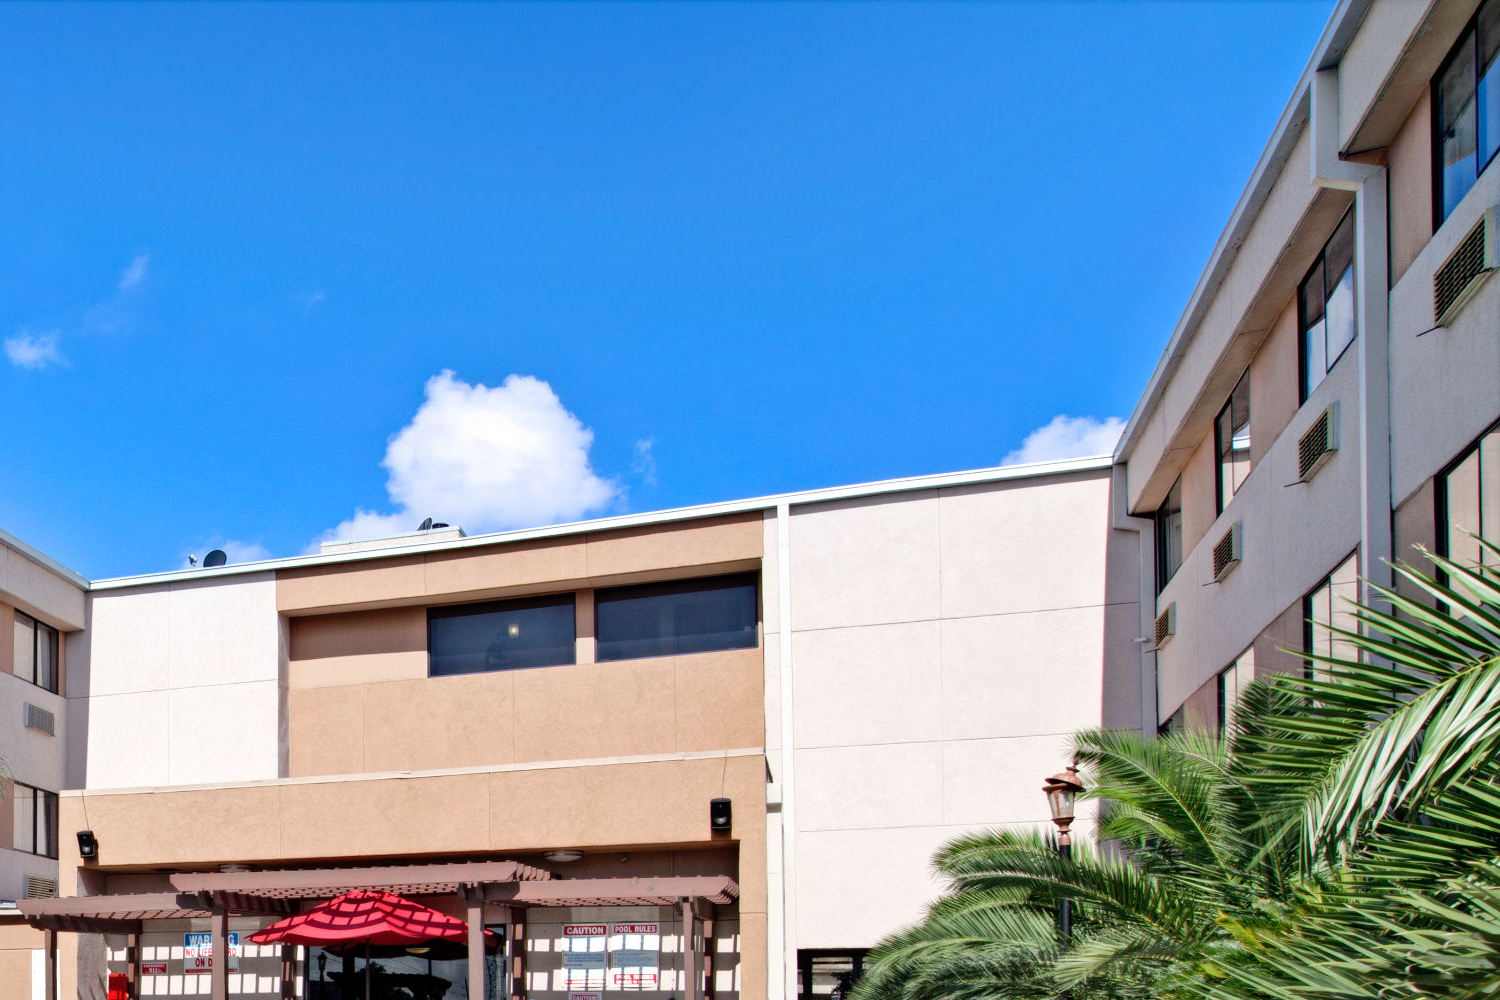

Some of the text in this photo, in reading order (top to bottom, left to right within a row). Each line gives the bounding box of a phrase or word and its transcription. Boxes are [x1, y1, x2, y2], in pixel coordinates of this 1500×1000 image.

[567, 926, 604, 935] CAUTION
[188, 934, 235, 946] WARG
[185, 947, 237, 958] NO LIFERD
[195, 958, 205, 967] ON
